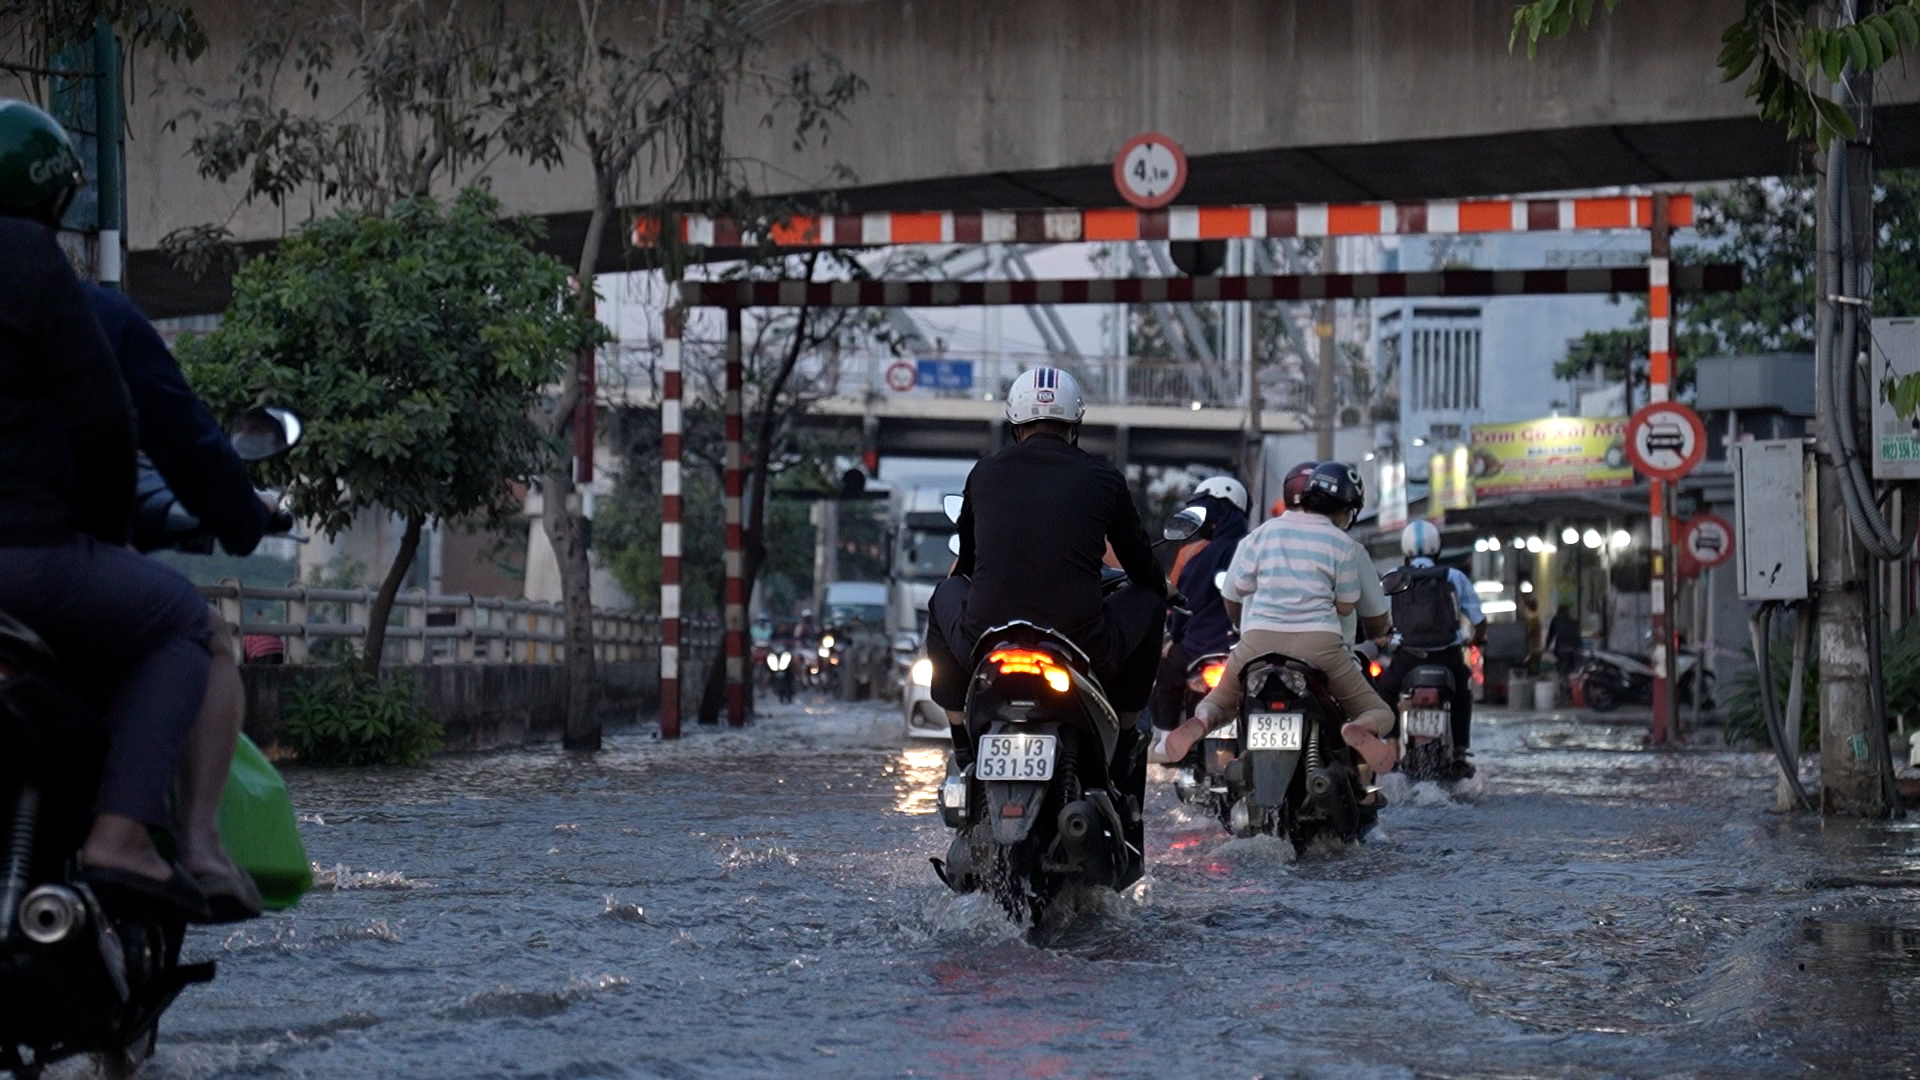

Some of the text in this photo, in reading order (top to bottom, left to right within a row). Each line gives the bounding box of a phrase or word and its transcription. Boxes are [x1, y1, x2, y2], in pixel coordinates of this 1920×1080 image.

[1257, 717, 1292, 731] 59-C1
[990, 739, 1044, 757] 59-V3
[983, 758, 1047, 777] 531.59
